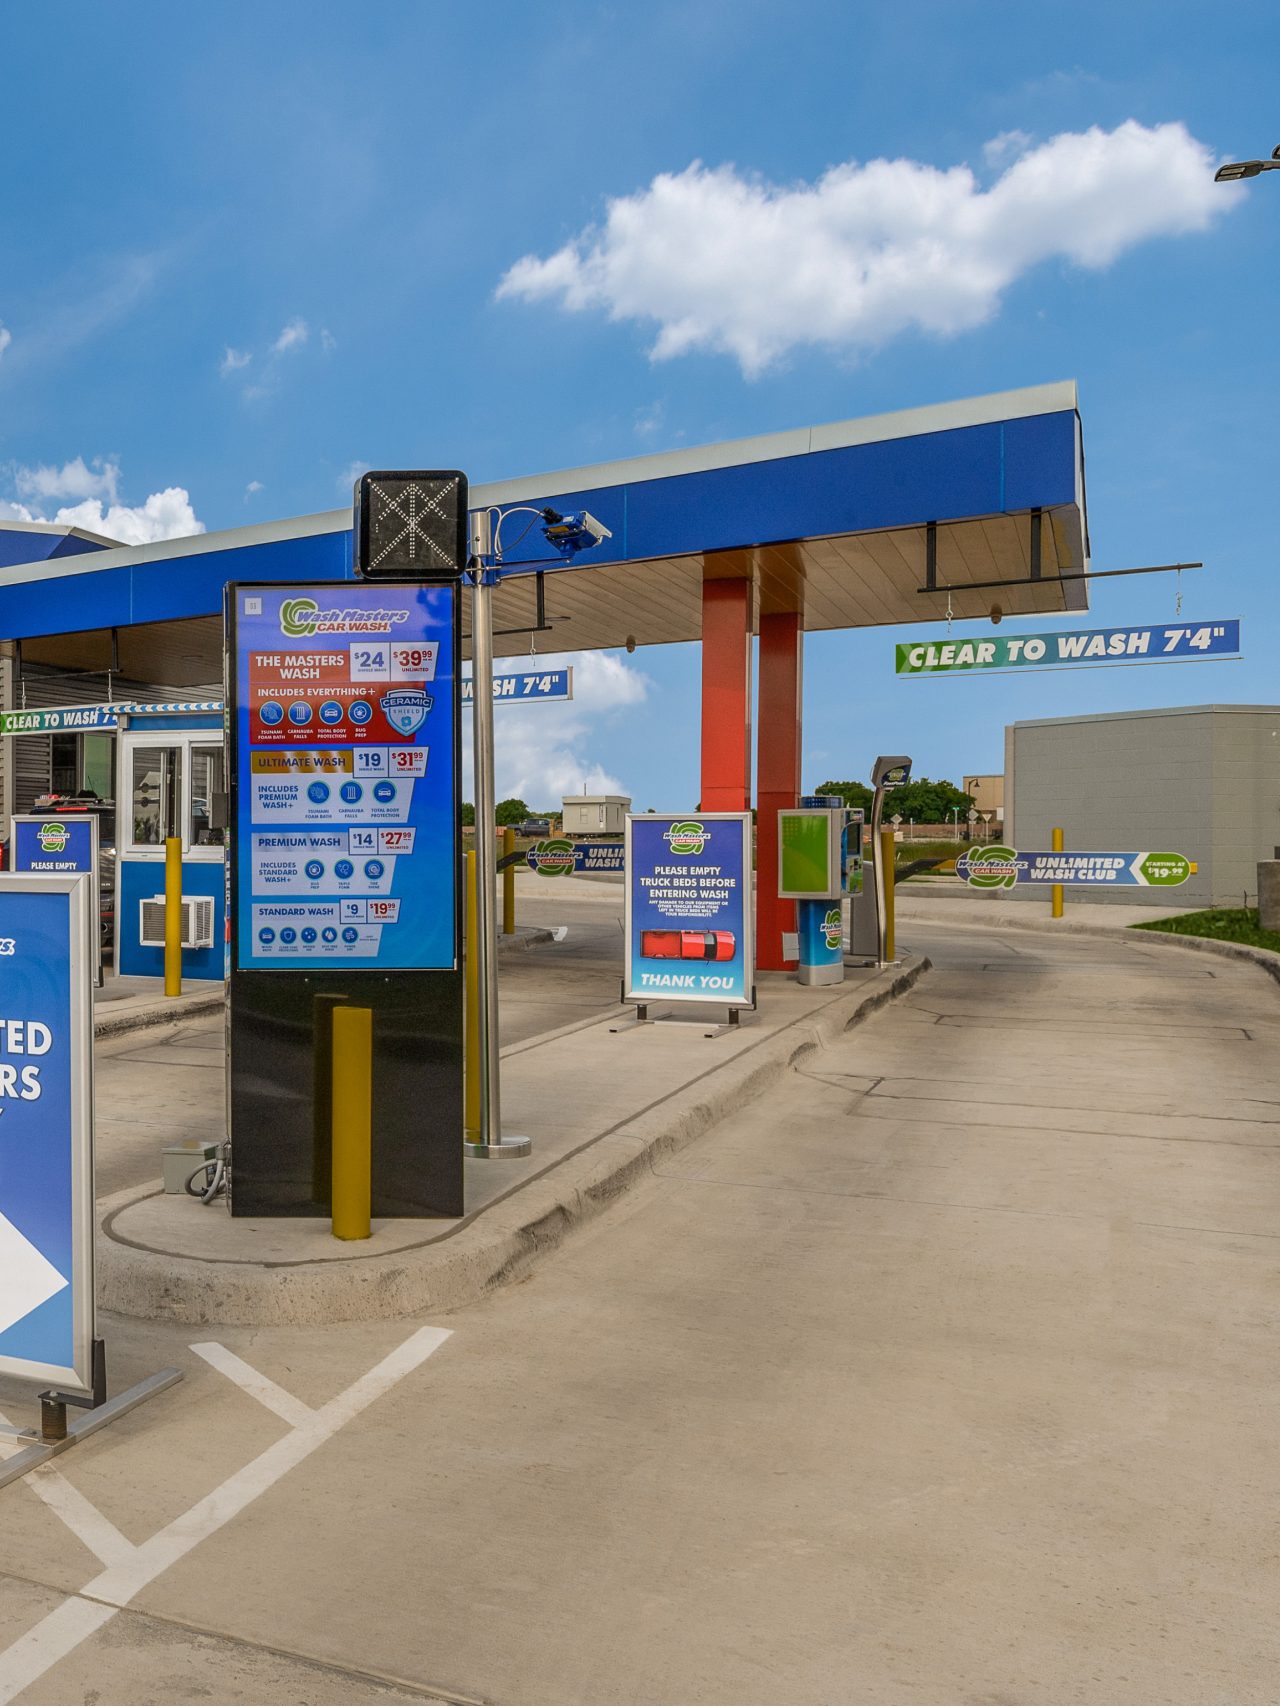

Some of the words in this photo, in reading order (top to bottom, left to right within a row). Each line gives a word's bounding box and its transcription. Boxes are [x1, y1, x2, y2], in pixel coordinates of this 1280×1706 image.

[297, 610, 340, 622] Wash
[340, 609, 407, 622] Masters
[317, 623, 345, 631] CAR
[908, 643, 996, 667] CLEAR
[1007, 639, 1046, 661] TO
[1058, 631, 1151, 658] WASH
[1163, 626, 1225, 651] 7'4"
[256, 656, 281, 667] THE
[284, 655, 344, 666] MASTERS
[354, 651, 384, 667] $24
[280, 668, 320, 679] WASH
[461, 678, 516, 698] WSH
[523, 675, 559, 694] 7'4"
[258, 688, 304, 697] INCLUDES
[383, 698, 430, 707] CERAMIC
[6, 715, 40, 729] CLEAR
[44, 713, 60, 727] TO
[63, 711, 98, 726] WASH
[258, 758, 310, 767] ULTIMATE
[313, 757, 346, 766] WASH
[358, 753, 381, 766] $19
[258, 838, 306, 847] PREMIUM
[309, 837, 341, 846] WASH
[353, 833, 373, 845] $14
[55, 862, 77, 870] EMPTY
[585, 858, 619, 867] WASH
[958, 860, 986, 868] Wash
[986, 860, 1026, 869] Masters
[1035, 857, 1125, 869] UNLIMITED
[655, 866, 688, 875] PLEASE
[690, 866, 721, 875] EMPTY
[1030, 869, 1076, 879] WASH
[1078, 869, 1117, 879] CLUB
[640, 878, 671, 887] TRUCK
[673, 878, 697, 887] BEDS
[700, 878, 736, 887] BEFORE
[649, 889, 697, 898] ENTERING
[700, 889, 729, 899] WASH
[259, 908, 305, 916] STANDARD
[346, 904, 359, 914] $9
[641, 974, 696, 987] THANK
[699, 975, 734, 989] YOU
